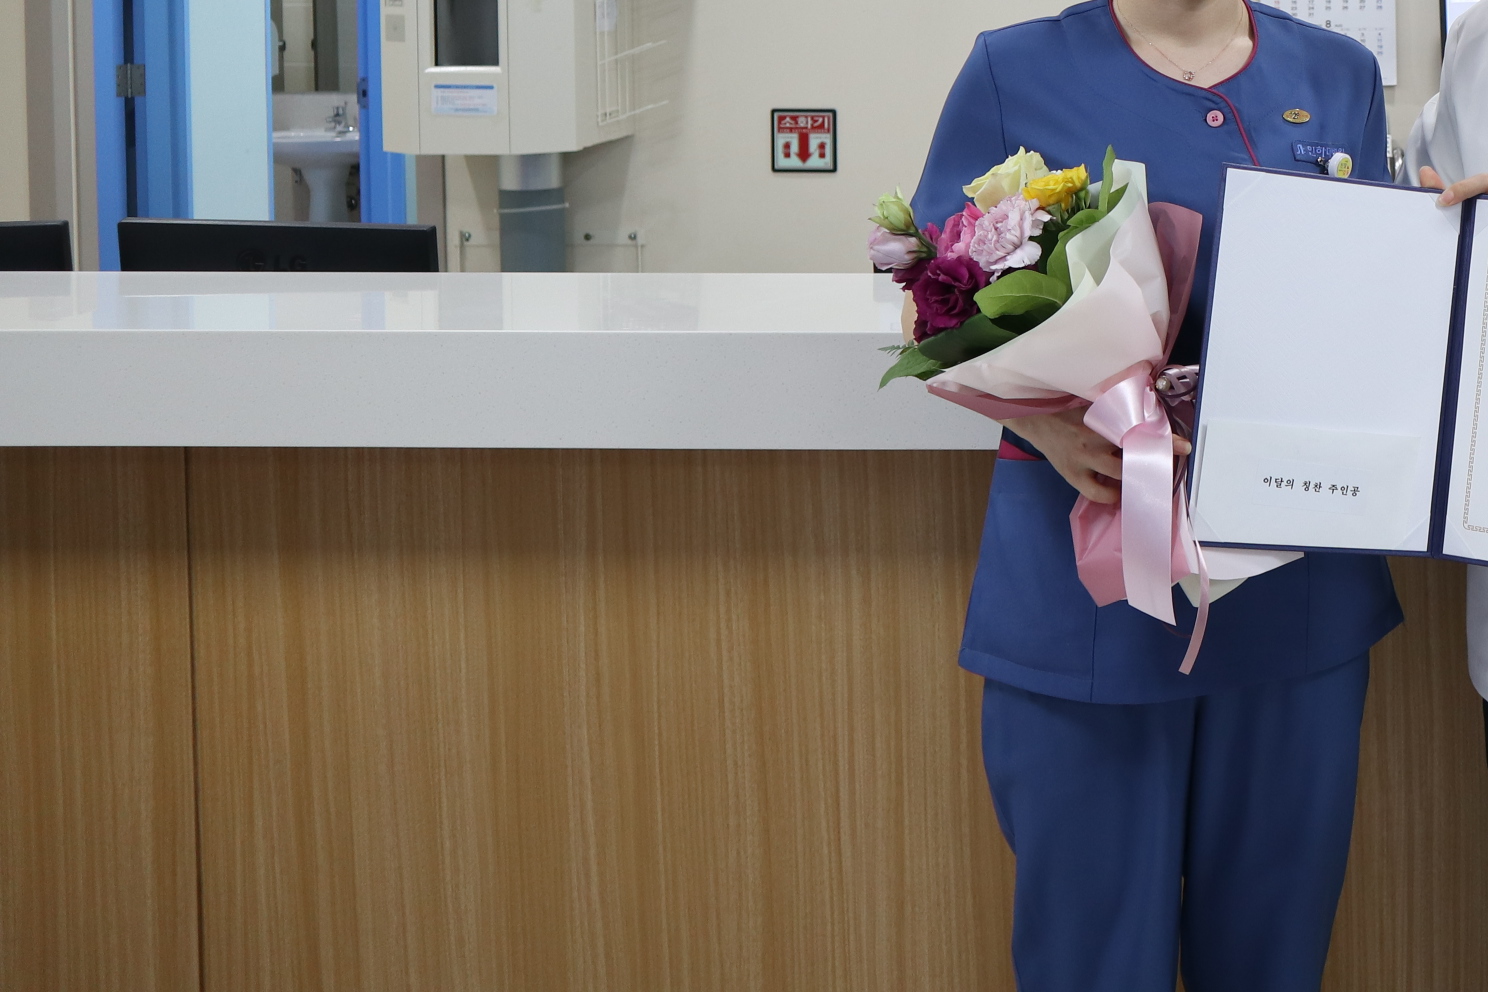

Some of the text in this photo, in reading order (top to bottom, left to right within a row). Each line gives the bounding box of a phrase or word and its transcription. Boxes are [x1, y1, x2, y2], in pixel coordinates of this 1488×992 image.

[780, 116, 828, 129] 소화기
[1263, 476, 1360, 497] 이달의 칭찬 주인공
